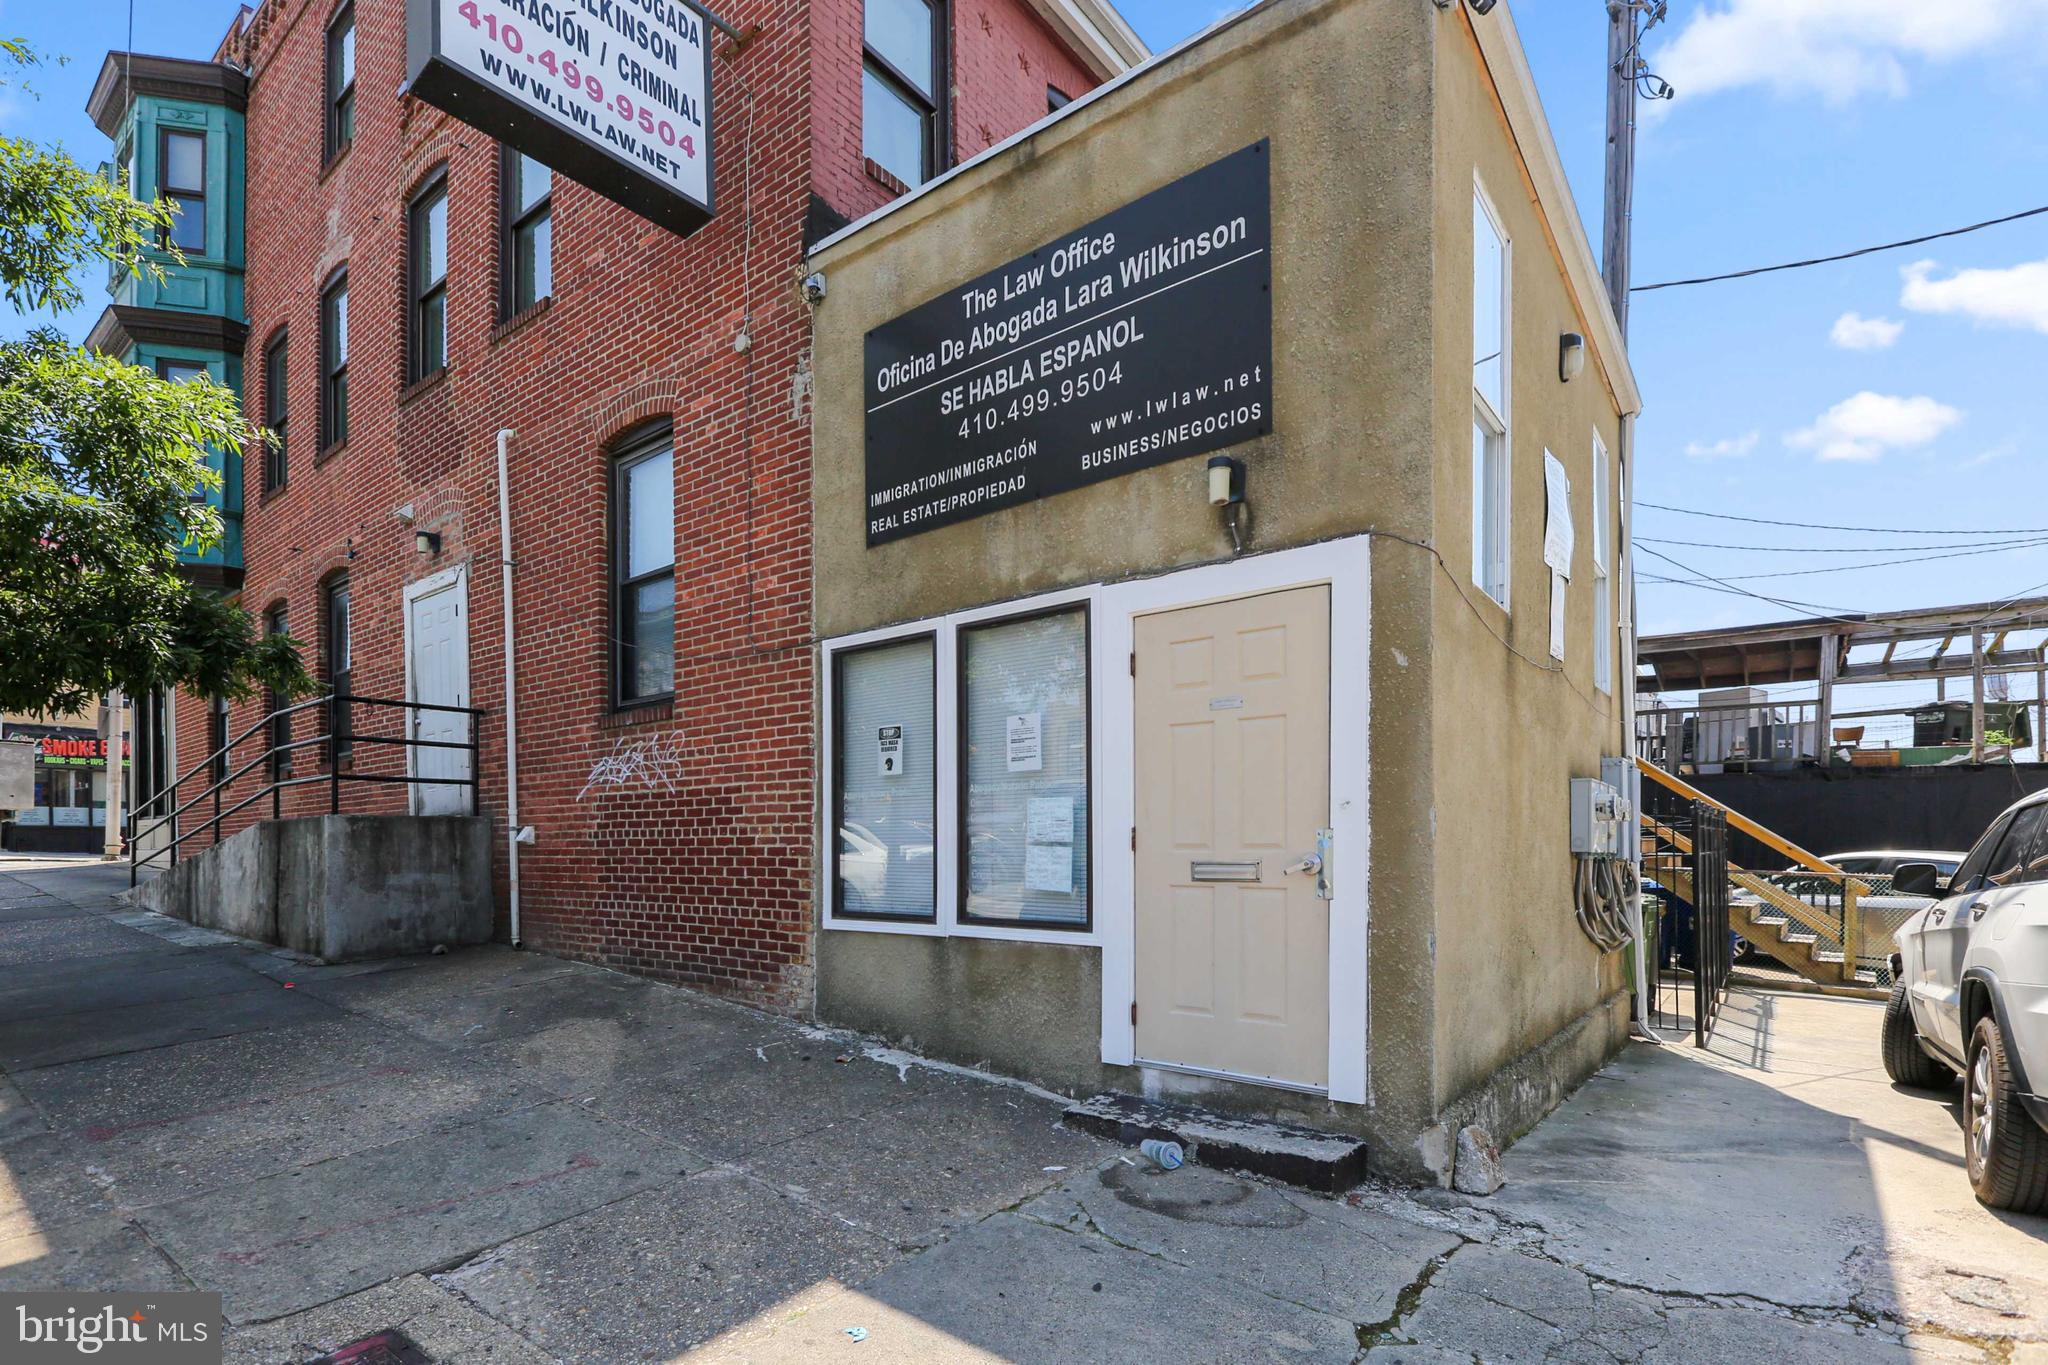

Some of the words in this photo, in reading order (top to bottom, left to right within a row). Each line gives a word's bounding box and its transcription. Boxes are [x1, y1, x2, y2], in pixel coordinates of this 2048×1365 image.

[571, 0, 677, 70] LKINSON
[629, 0, 699, 48] OGADA
[458, 0, 696, 159] 410.499.9504
[500, 0, 589, 57] ACIÓN
[600, 42, 607, 66] /
[618, 52, 701, 127] CRIMINAL
[480, 48, 681, 180] WWW.LWLAW.NET
[877, 352, 936, 392] Oficina
[941, 340, 965, 366] De
[969, 296, 1057, 354] Abogada
[1065, 274, 1113, 313] Lara
[1120, 216, 1246, 288] Wilkinson
[962, 287, 997, 319] The
[1004, 264, 1044, 301] Law
[1050, 232, 1115, 278] Office
[940, 386, 964, 415] SE
[969, 359, 1035, 405] HABLA
[1040, 316, 1144, 377] ESPANOL
[958, 361, 1123, 438] 410.499.9504
[1090, 365, 1261, 434] www.lwlaw.net
[871, 438, 1037, 507] IMMIGRATION/INMIGRACIÓN
[1082, 402, 1262, 470] BUSINESS/NEGOCIOS
[871, 514, 899, 534] REAL
[904, 475, 1026, 525] ESTATE/PROPIEDAD
[42, 737, 97, 756] SMOKE
